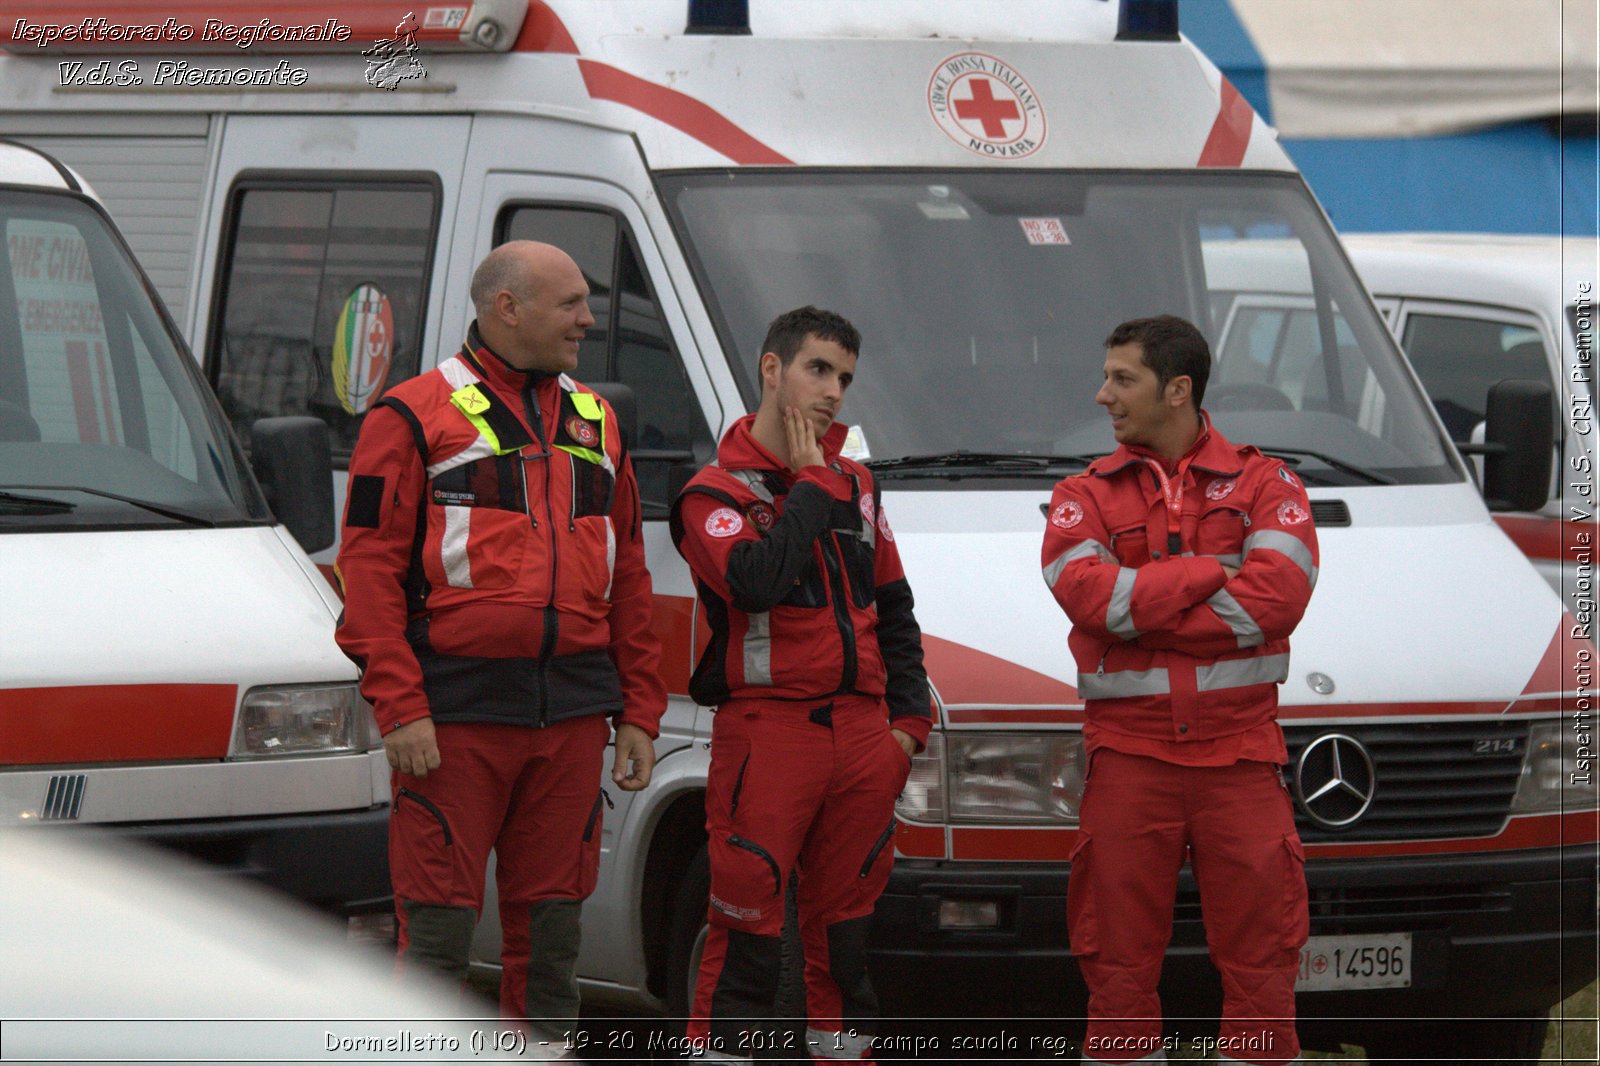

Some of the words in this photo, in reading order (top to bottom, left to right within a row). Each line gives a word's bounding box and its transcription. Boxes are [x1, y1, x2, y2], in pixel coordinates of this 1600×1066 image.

[932, 74, 949, 113] CROCE
[946, 55, 986, 77] ROSSA
[992, 61, 1037, 112] ITALIANA
[969, 138, 1036, 157] NOVARA
[1023, 220, 1040, 231] NO
[1475, 738, 1516, 752] 214
[1333, 945, 1405, 980] 14596
